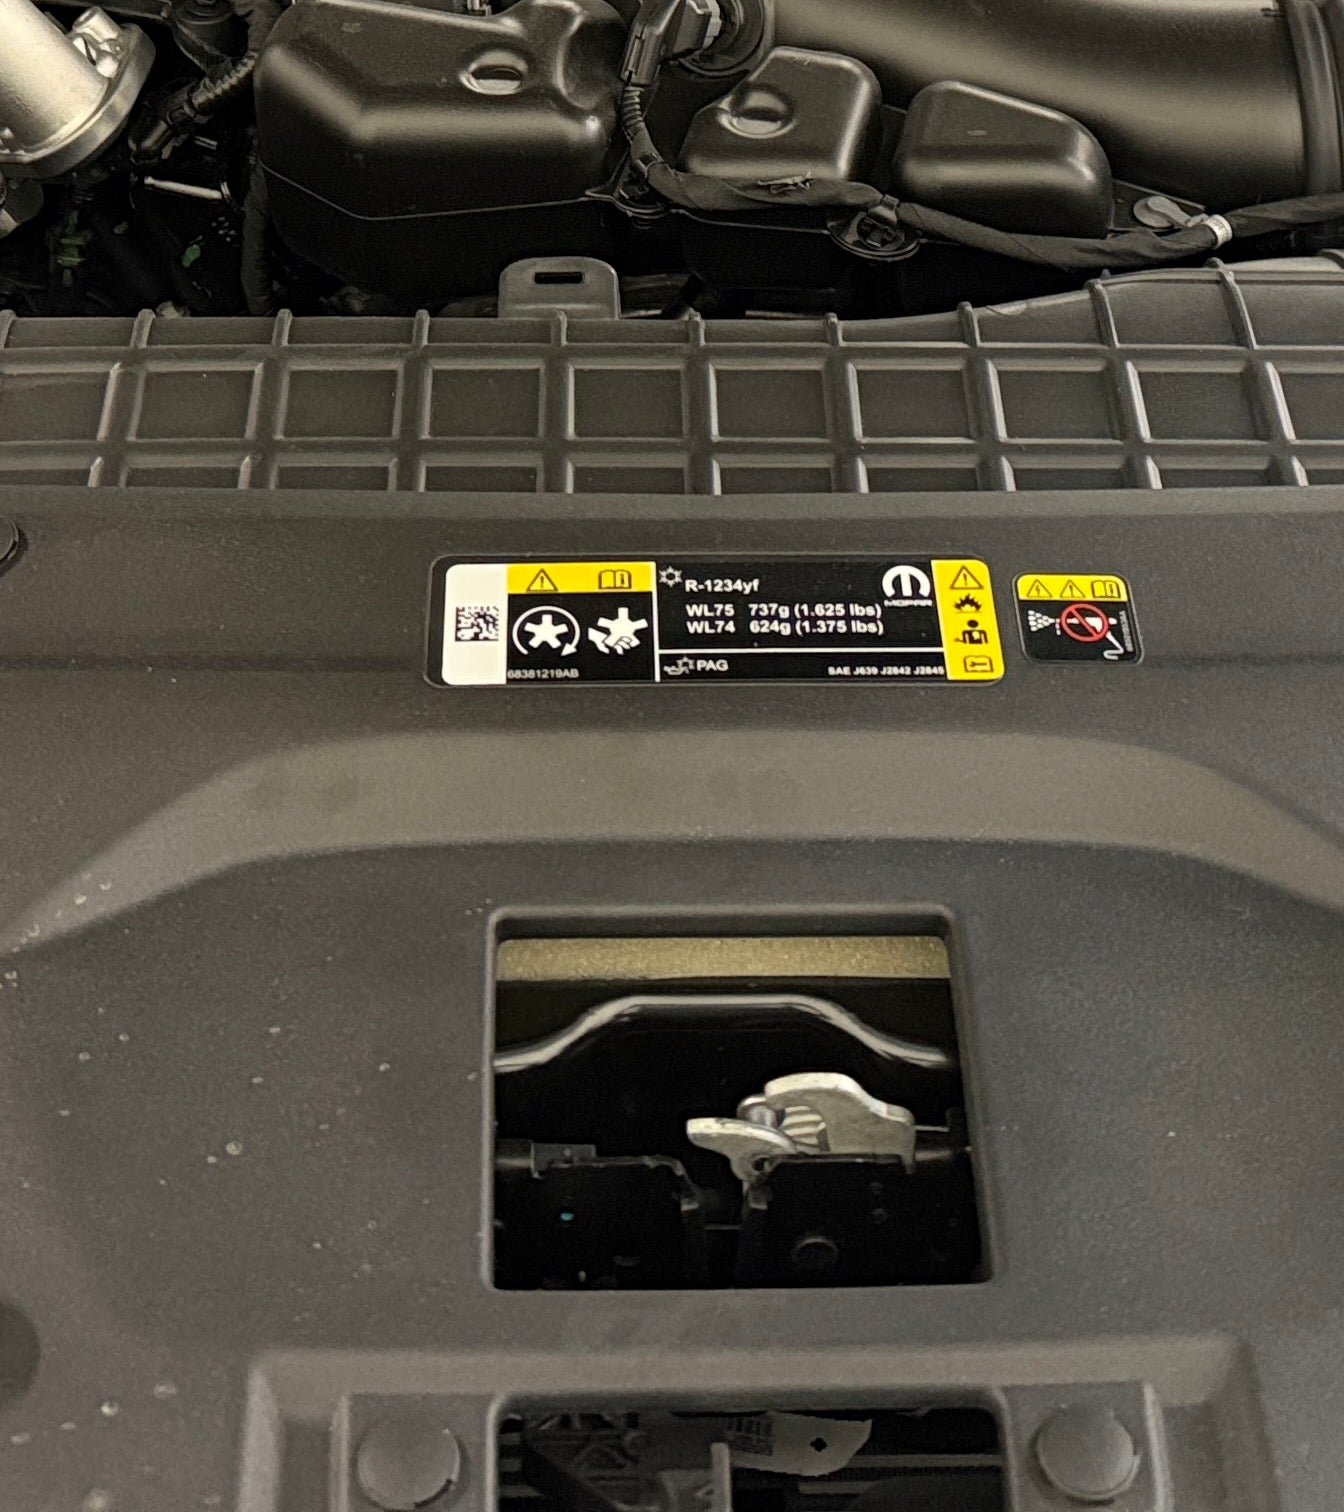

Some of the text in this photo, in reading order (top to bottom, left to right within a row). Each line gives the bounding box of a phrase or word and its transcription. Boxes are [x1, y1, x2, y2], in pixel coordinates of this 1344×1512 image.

[685, 578, 760, 594] R-1234yf
[883, 598, 932, 607] MOPAR
[685, 603, 883, 619] WL75 737g (1.625 lbs)
[686, 620, 884, 637] WL74 624g (1.375 lbs)
[696, 659, 730, 672] PAG
[827, 666, 851, 676] SAE
